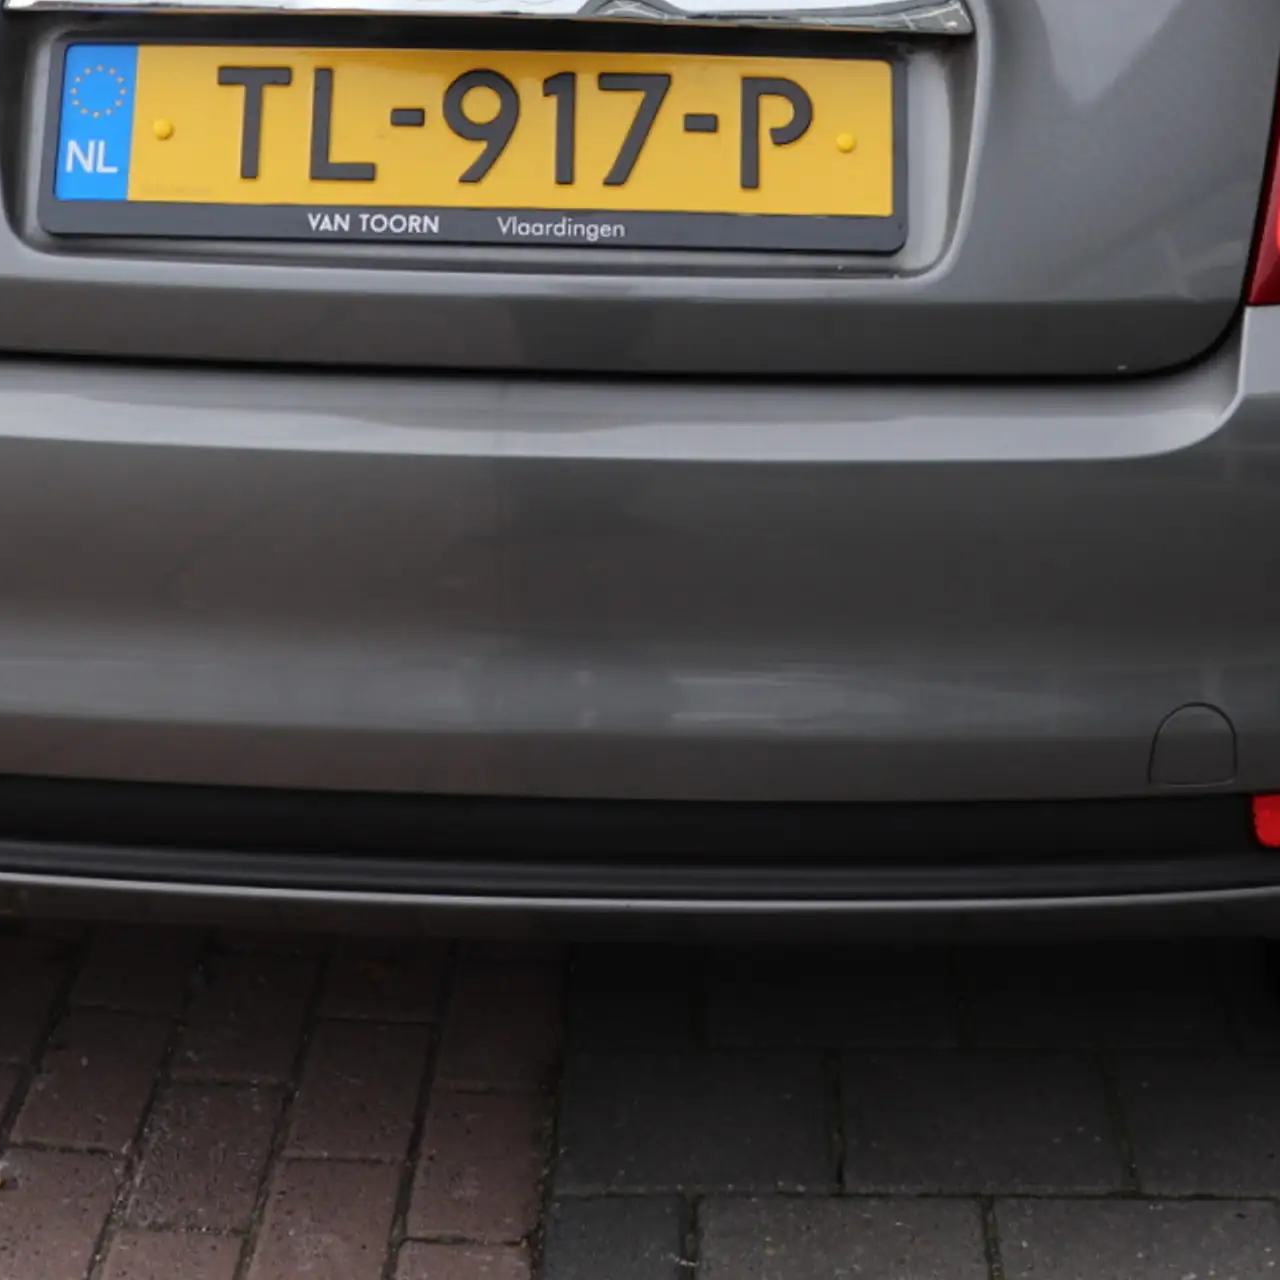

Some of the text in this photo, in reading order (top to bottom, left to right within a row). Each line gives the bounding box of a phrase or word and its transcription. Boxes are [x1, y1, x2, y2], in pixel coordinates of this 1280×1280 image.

[66, 65, 814, 190] NL TL-917-P
[307, 214, 626, 242] VAN TOORN Vlaardingen
